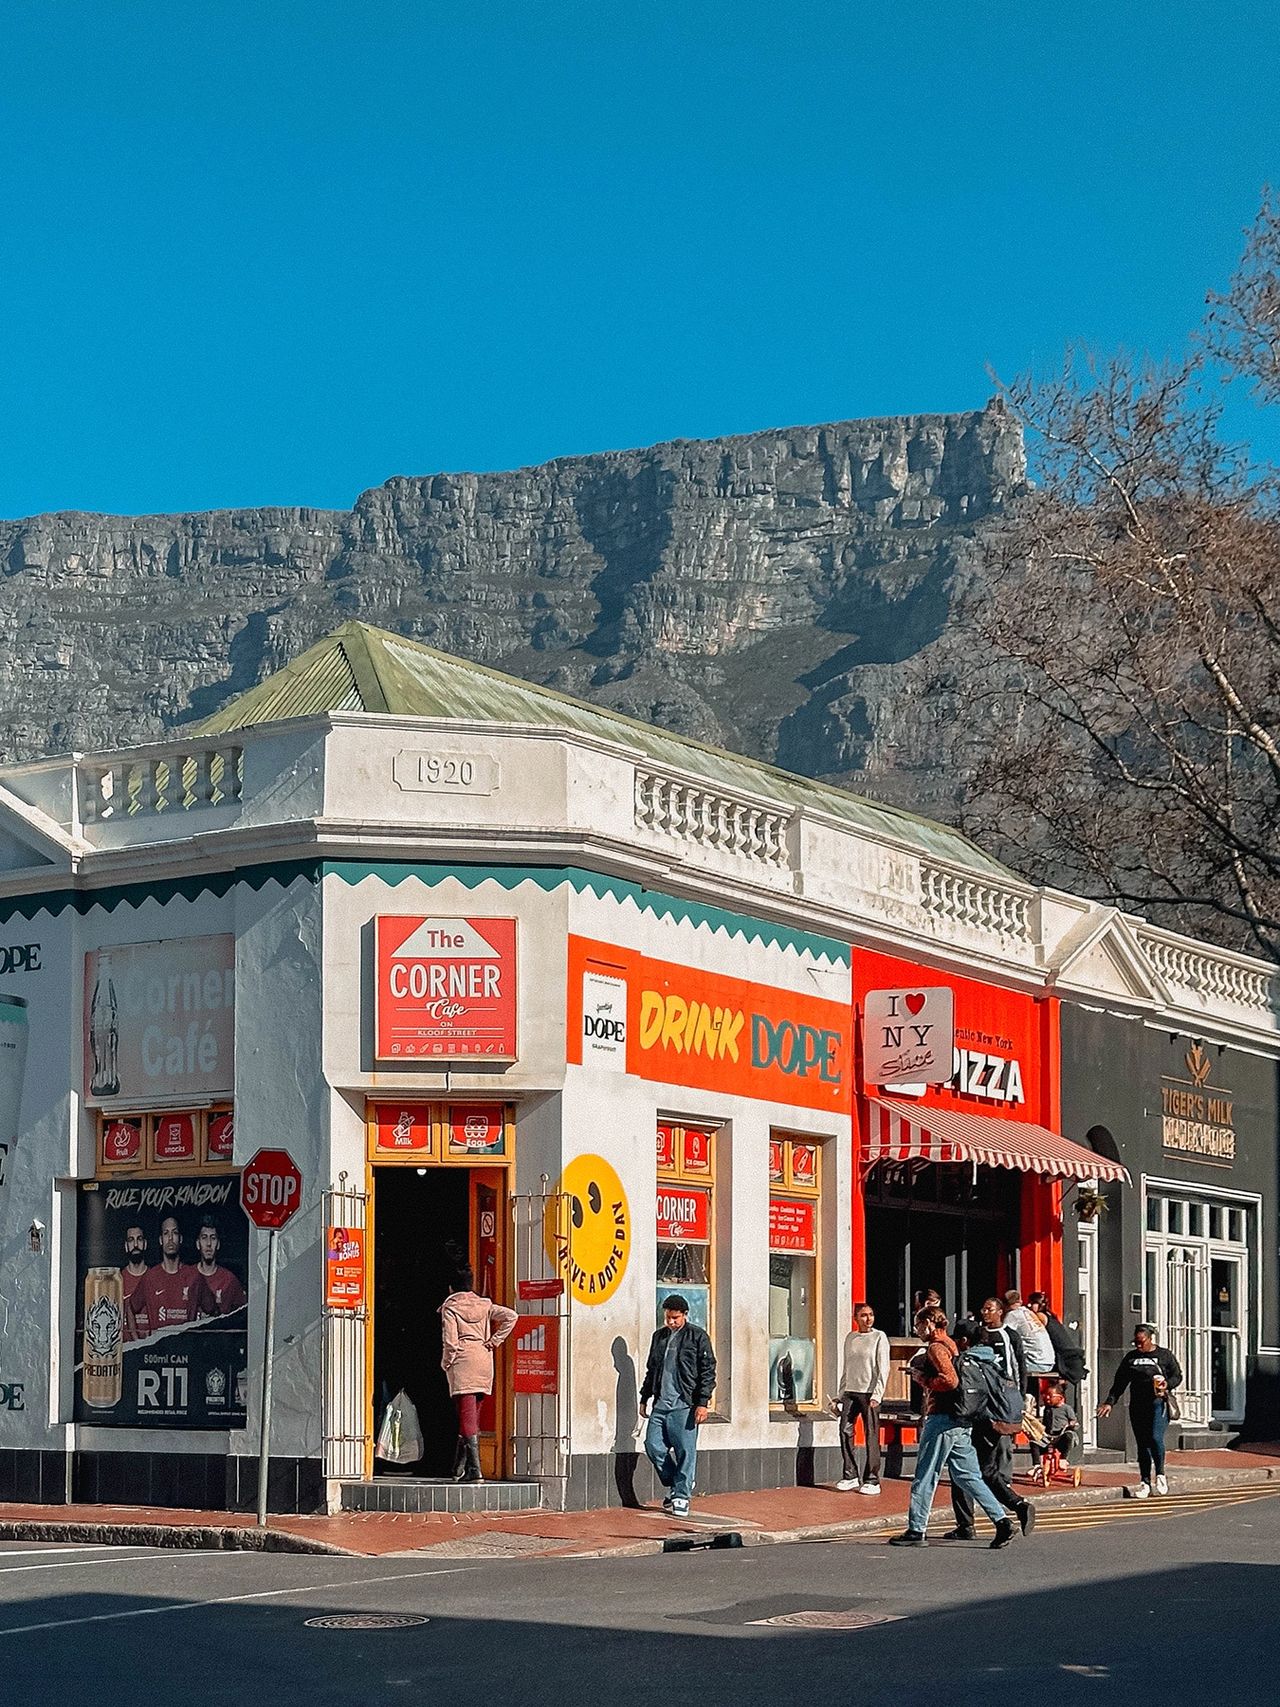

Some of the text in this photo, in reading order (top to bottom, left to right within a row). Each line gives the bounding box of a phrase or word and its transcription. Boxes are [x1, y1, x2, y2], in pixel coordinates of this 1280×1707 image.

[417, 756, 473, 786] 1920
[427, 929, 465, 948] The
[389, 963, 502, 998] CORNER
[426, 998, 471, 1020] Cafe
[447, 1029, 477, 1037] STREET
[584, 1015, 625, 1043] DOPE
[639, 990, 842, 1083] DRINK DOPE
[955, 1028, 1013, 1050] entic New York
[1162, 1088, 1233, 1126] TIGER'S MILK
[395, 1138, 412, 1146] Milk
[105, 1181, 232, 1213] RULE YOUR KINGDOM
[246, 1173, 297, 1206] STOP
[656, 1195, 697, 1223] CORNER
[589, 1274, 596, 1293] A
[598, 1245, 623, 1291] DOPE
[612, 1201, 625, 1240] DAY
[170, 1354, 189, 1364] CAN
[137, 1368, 189, 1407] R11
